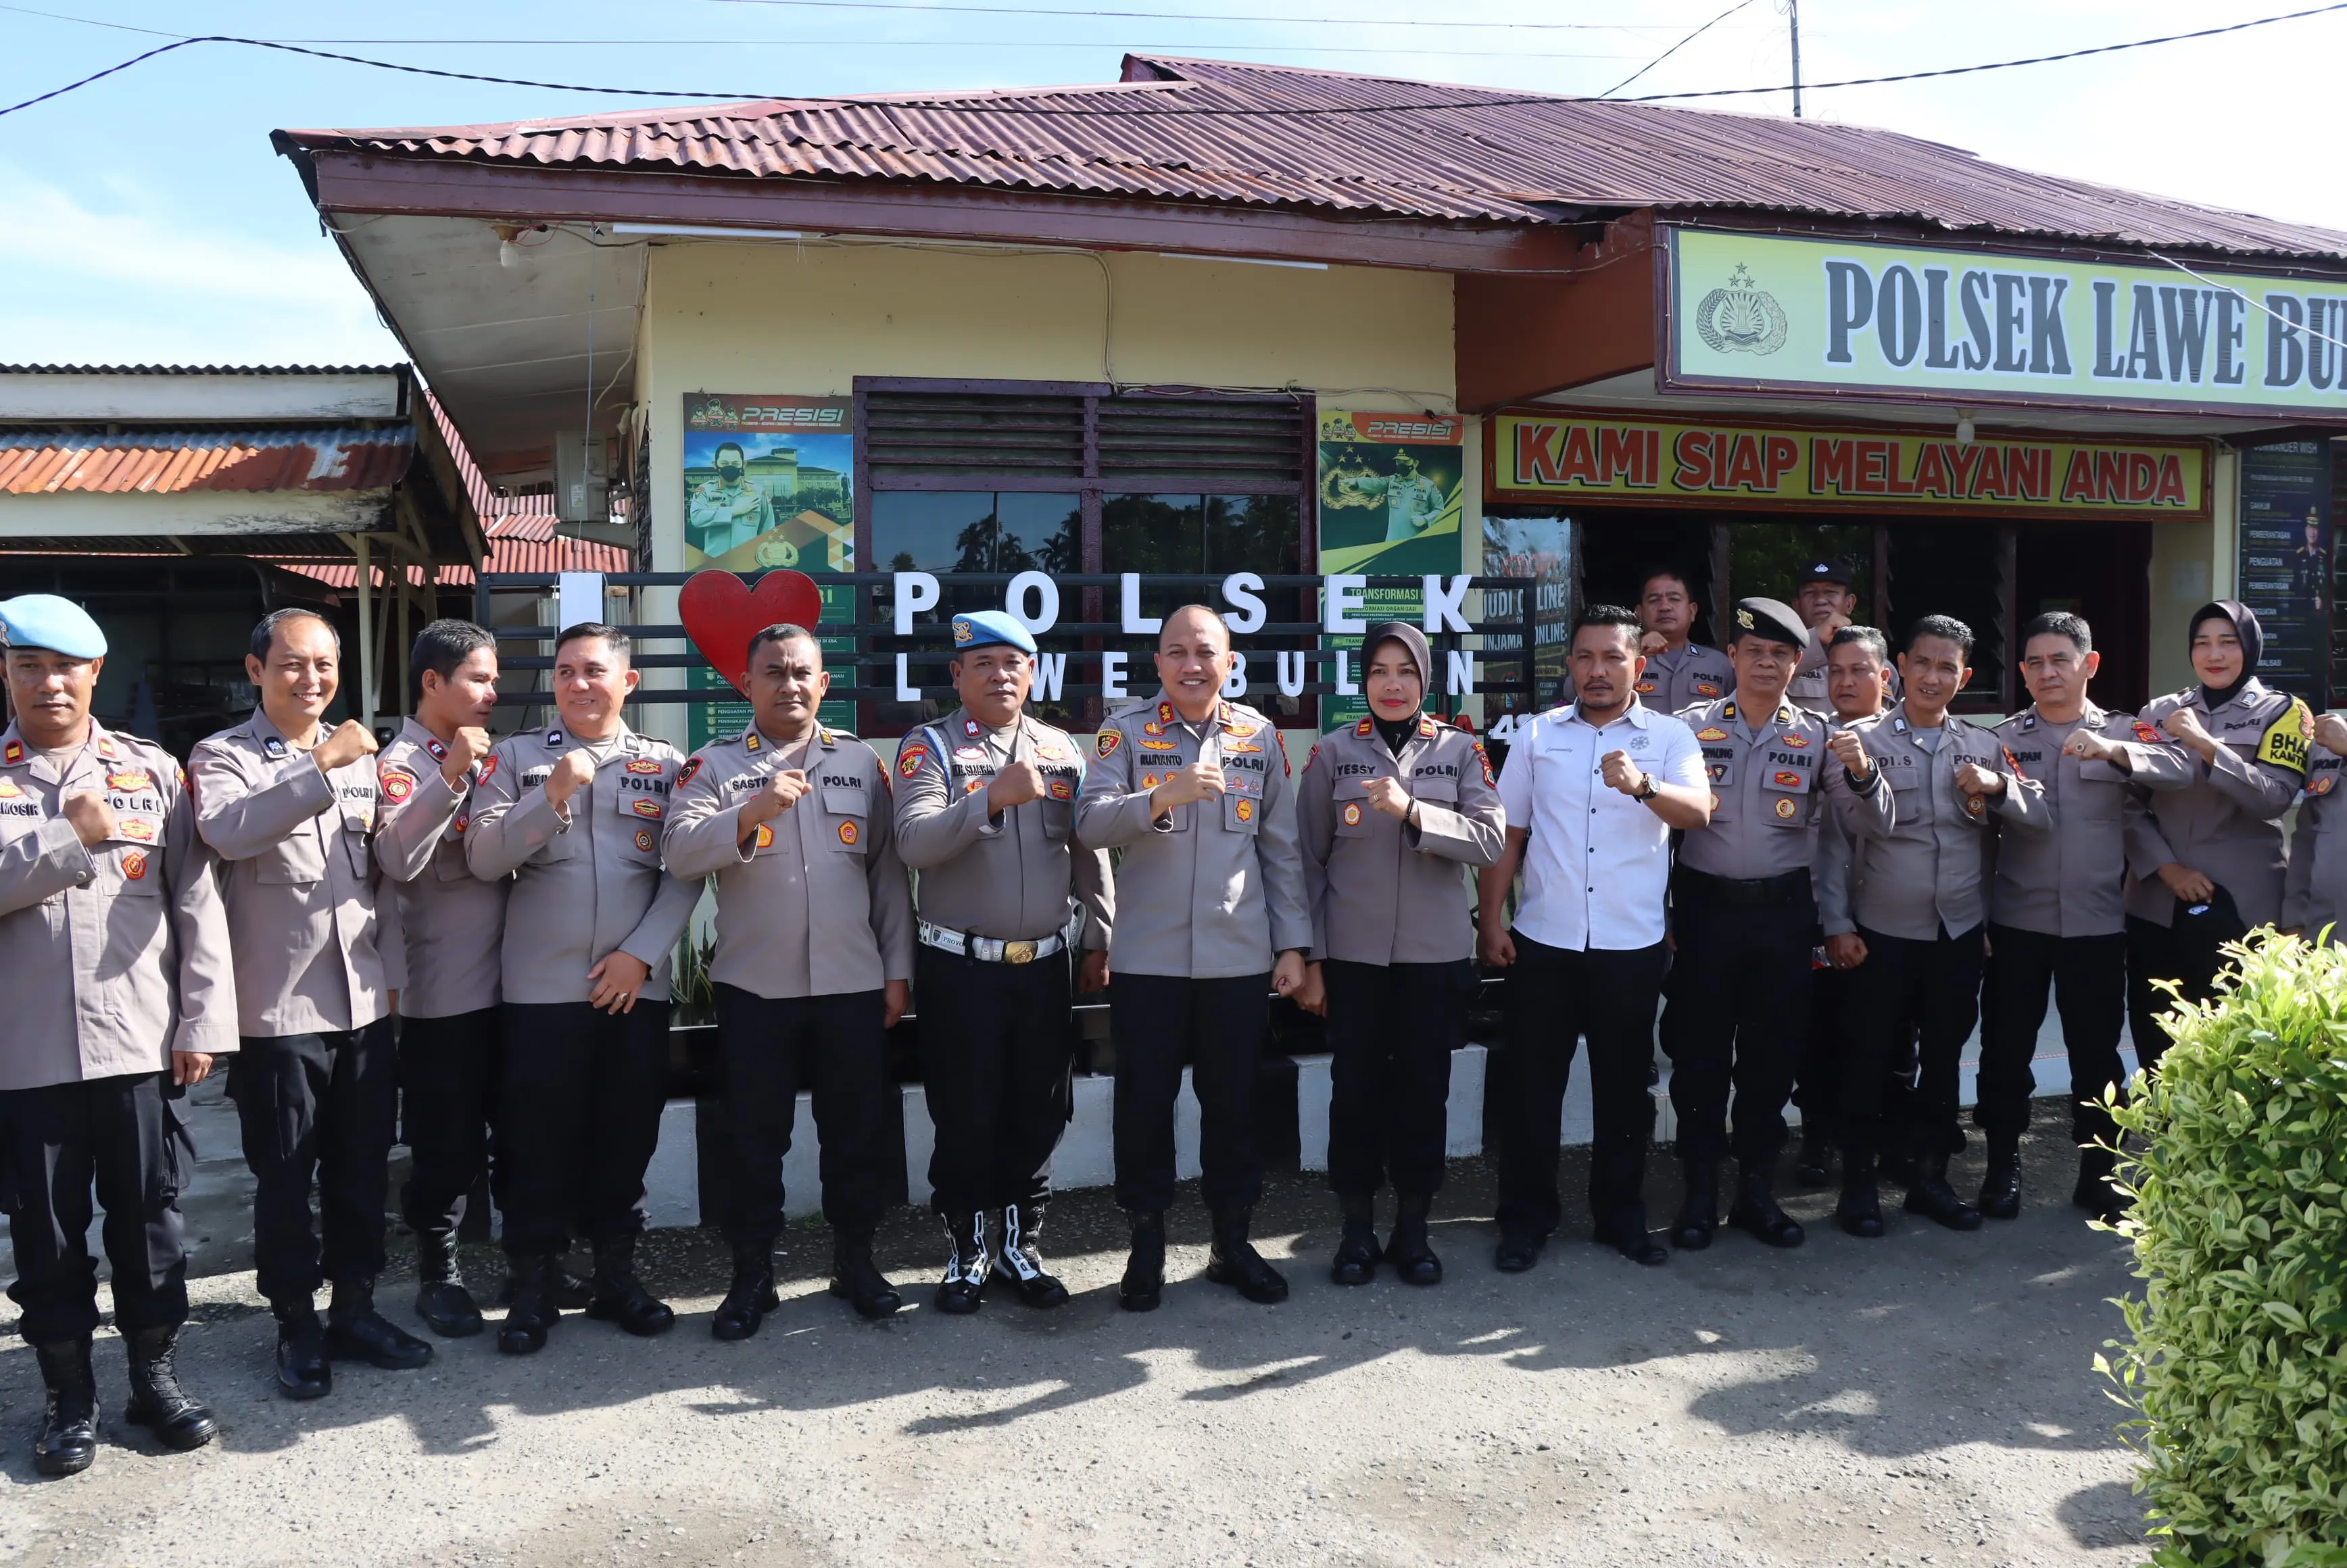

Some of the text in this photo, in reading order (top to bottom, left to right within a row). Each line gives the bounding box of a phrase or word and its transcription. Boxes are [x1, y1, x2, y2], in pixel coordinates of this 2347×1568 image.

[1825, 261, 2073, 376] POLSEK
[2091, 281, 2246, 386] LAWE
[742, 407, 844, 422] PRESISI
[1368, 421, 1453, 436] PRESISI
[2300, 442, 2318, 454] WISH
[1514, 422, 2187, 506] KAMI SIAP MELAYANI ANDA
[2249, 558, 2283, 566] PENGUATAN
[1351, 588, 1418, 600] TRANSFORMASI
[894, 571, 1473, 636] POLSEK
[896, 650, 1474, 702] LWE BULN
[1693, 672, 1723, 684] POLRI
[2224, 718, 2261, 731] POLRI
[1222, 756, 1264, 772] POLRI
[1768, 751, 1813, 768] POLRI
[1954, 754, 1991, 772] POLRI
[1336, 764, 1376, 776] YESSY
[1416, 764, 1458, 777] POLRI
[620, 777, 670, 795] POLRI
[823, 775, 862, 789] POLRI
[341, 786, 374, 799] POLRI
